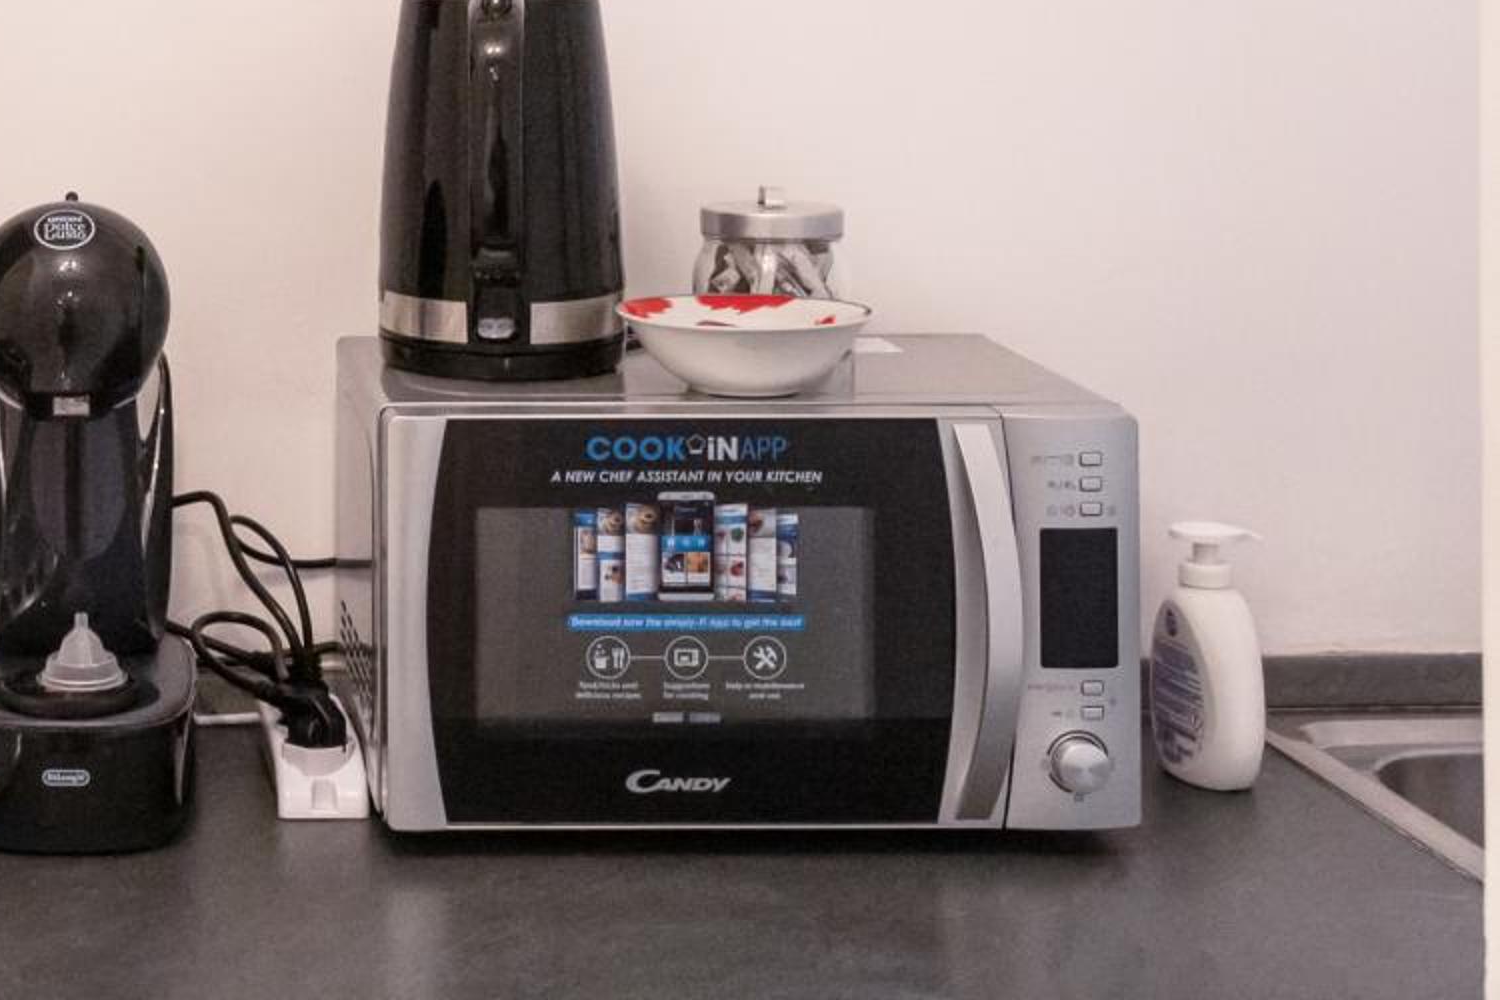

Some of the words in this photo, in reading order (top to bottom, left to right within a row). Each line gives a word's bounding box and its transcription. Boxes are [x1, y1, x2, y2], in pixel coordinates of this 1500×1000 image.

[586, 436, 687, 461] COOK
[550, 470, 561, 483] A
[565, 470, 596, 483] NEW
[599, 470, 634, 483] CHEF
[637, 470, 704, 483] ASSISTANT
[707, 470, 723, 483] IN
[725, 470, 763, 483] YOUR
[765, 470, 823, 483] KITCHEN
